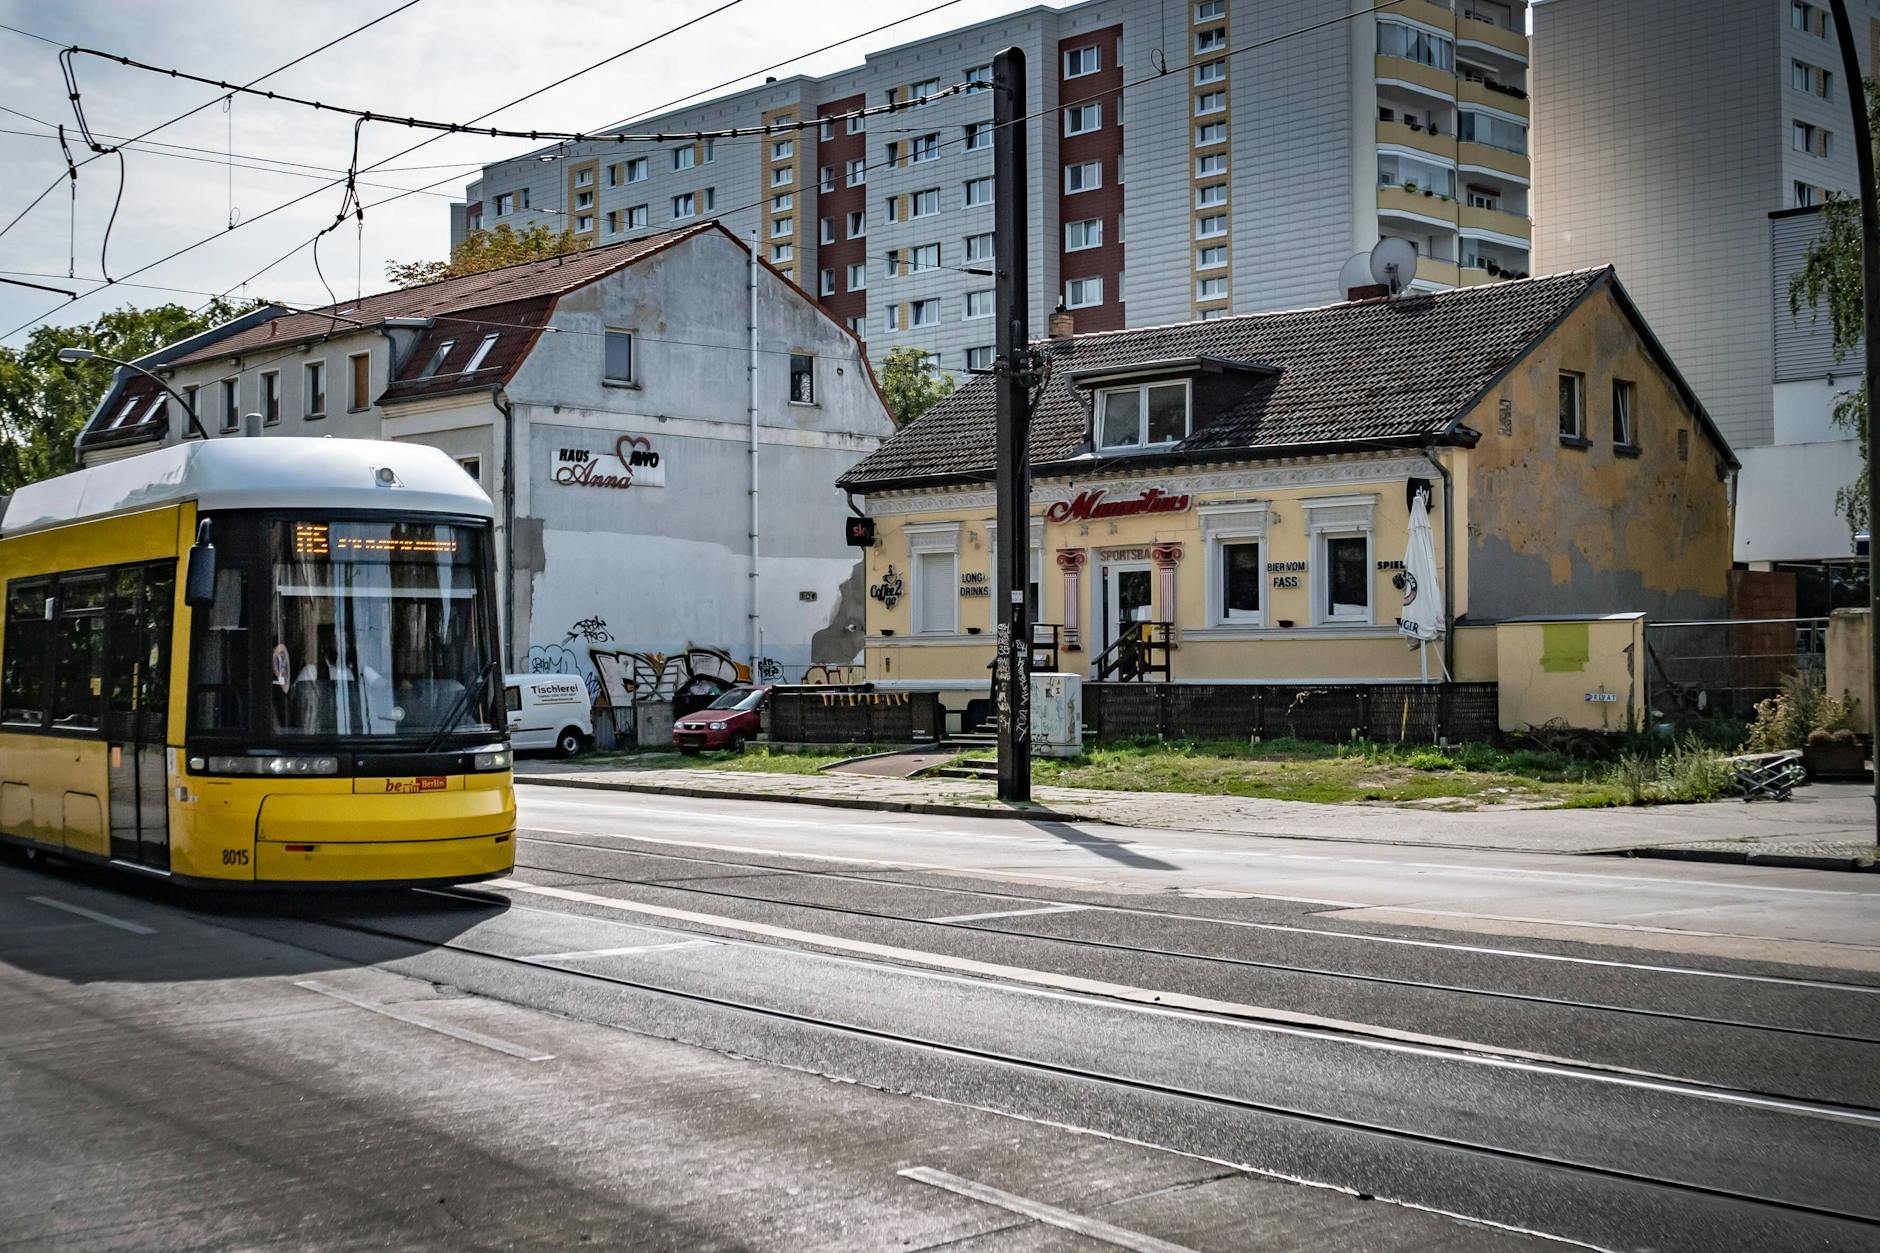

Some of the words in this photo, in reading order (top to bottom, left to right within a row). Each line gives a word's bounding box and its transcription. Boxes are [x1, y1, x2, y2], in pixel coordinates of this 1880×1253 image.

[560, 448, 590, 463] HAUS
[629, 450, 659, 468] AWO
[556, 458, 632, 489] Anna
[1416, 485, 1430, 505] sky
[1267, 562, 1285, 572] BIER
[1286, 561, 1305, 571] VOM
[961, 572, 983, 583] LONG
[1273, 576, 1298, 587] FASS
[870, 583, 895, 600] Coffee
[895, 580, 902, 596] 2
[960, 586, 989, 597] DRINKS
[530, 683, 579, 695] Tischlerei
[385, 778, 402, 792] be
[421, 779, 445, 788] Berlin
[222, 849, 249, 865] 8015
